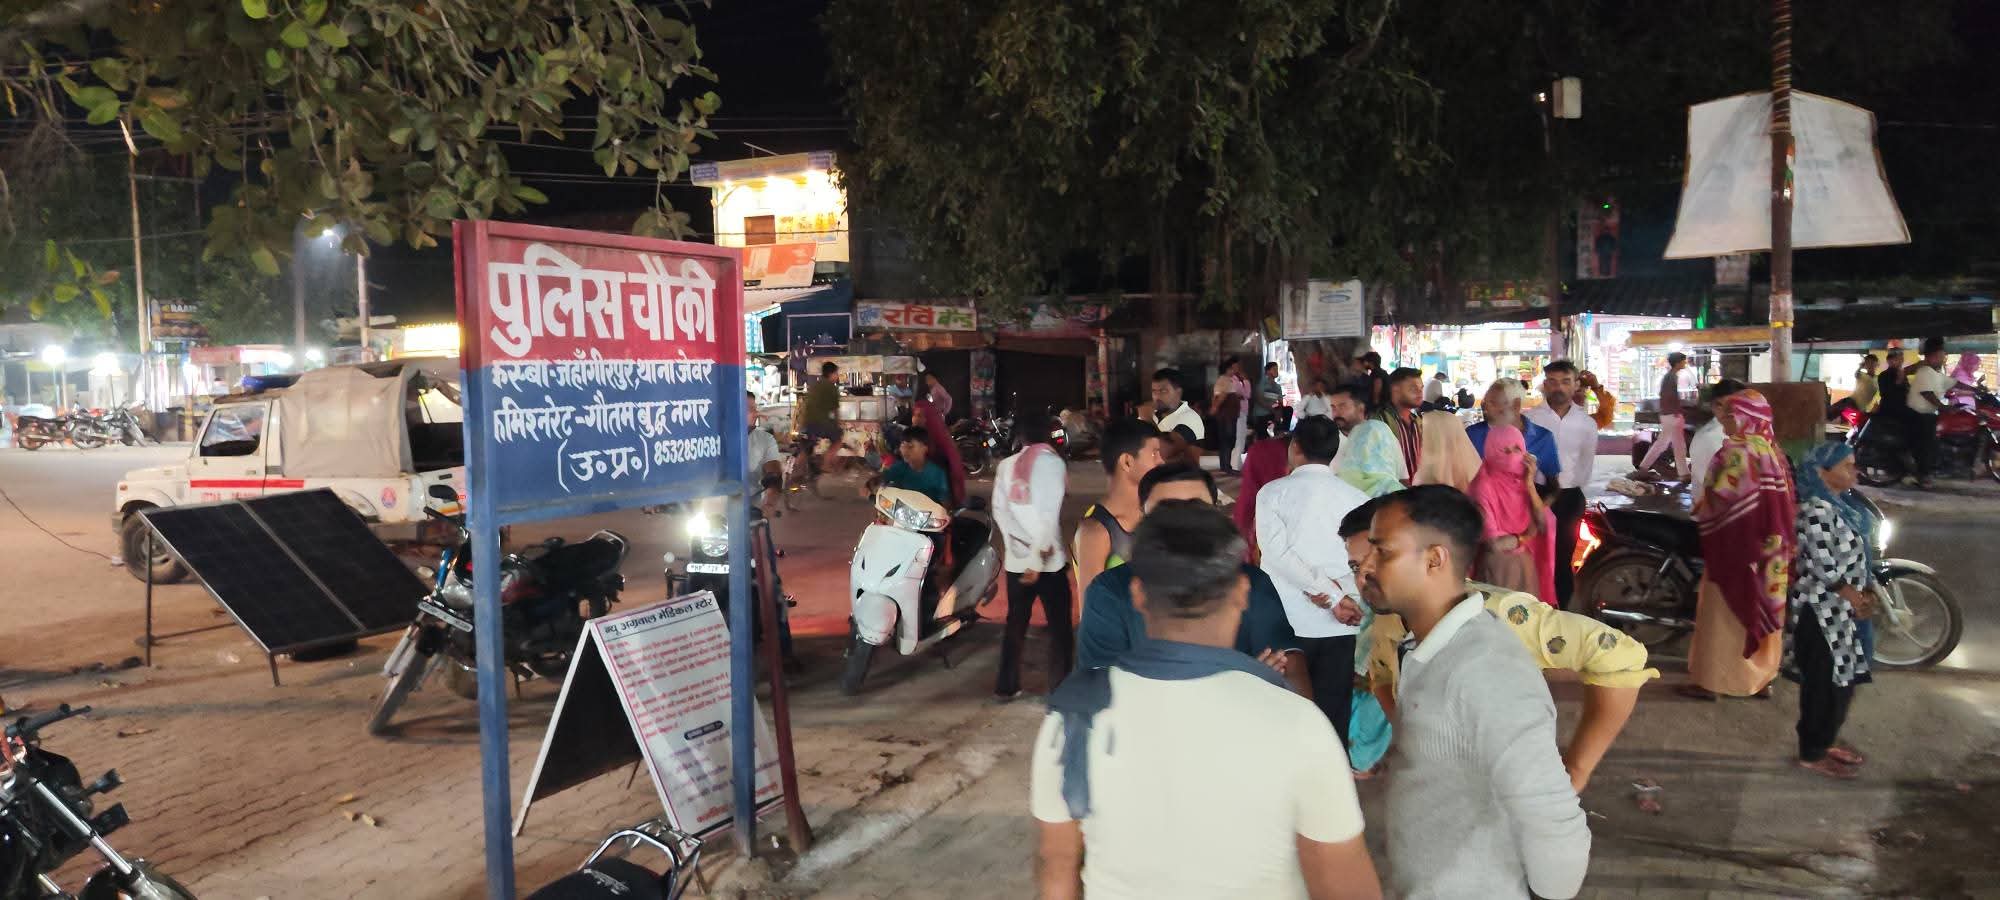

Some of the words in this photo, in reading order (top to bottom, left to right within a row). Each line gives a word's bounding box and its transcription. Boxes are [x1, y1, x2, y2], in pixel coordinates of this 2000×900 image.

[488, 243, 627, 358] पुलिस
[627, 253, 716, 343] चौकी
[671, 398, 713, 429] नगर
